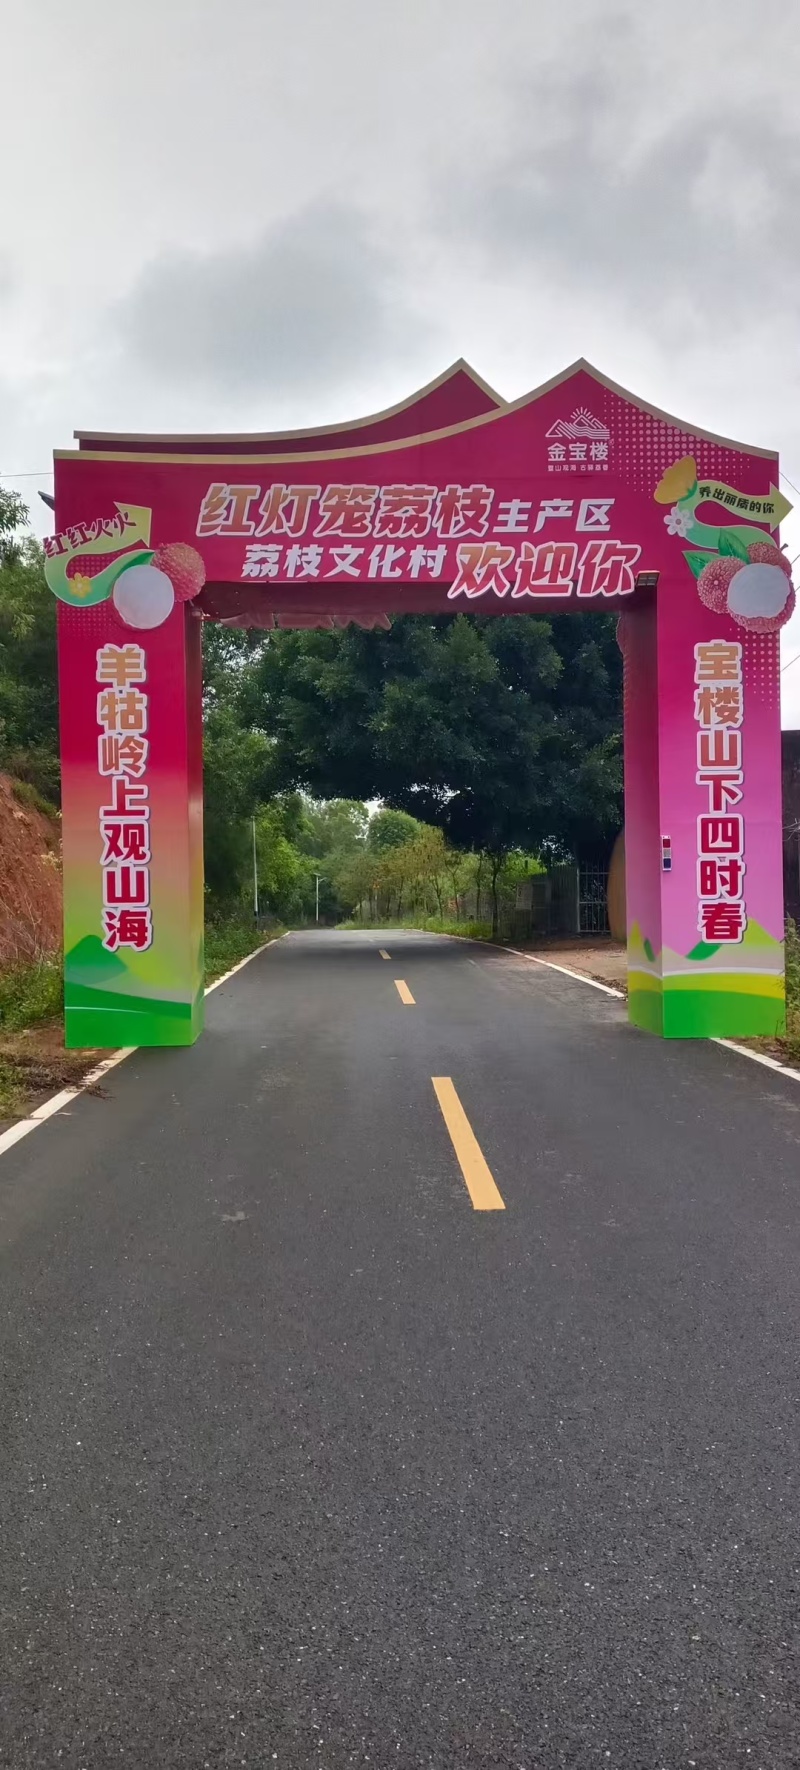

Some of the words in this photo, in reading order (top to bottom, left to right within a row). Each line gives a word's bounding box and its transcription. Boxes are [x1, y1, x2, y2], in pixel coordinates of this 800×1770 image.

[547, 442, 609, 461] 金宝楼
[196, 483, 495, 538] 红灯笼荔枝
[492, 498, 616, 534] 主产区
[699, 485, 775, 514] 养出丽质的你
[42, 511, 137, 559] 红红火火
[240, 544, 447, 578] 荔枝文化村
[447, 540, 642, 600] 欢迎你
[96, 643, 152, 953] 羊牯岭上观山海
[694, 640, 747, 945] 宝楼山下四时春
